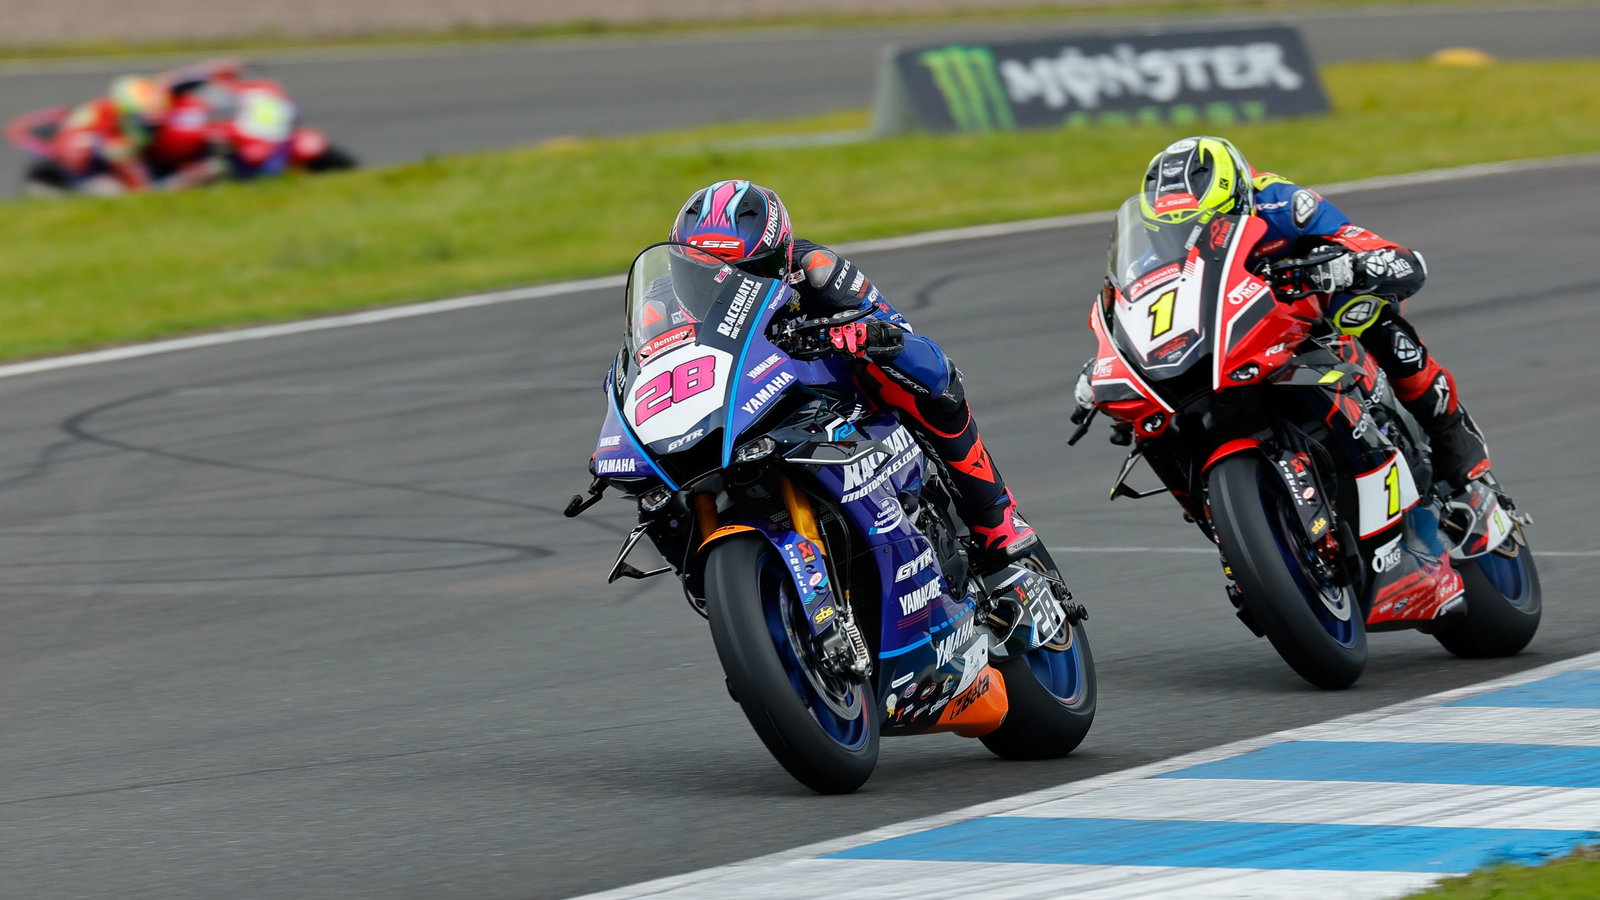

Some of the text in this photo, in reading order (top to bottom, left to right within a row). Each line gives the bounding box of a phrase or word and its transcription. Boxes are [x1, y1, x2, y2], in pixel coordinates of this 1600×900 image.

[1000, 42, 1302, 109] MONSTER
[690, 239, 741, 249] LS2
[763, 200, 779, 248] BURNELL
[717, 277, 755, 337] RACEWAYS
[1149, 287, 1179, 342] 1
[1228, 281, 1262, 305] OMG
[747, 353, 782, 380] YAMALUBE
[635, 355, 716, 427] 28
[741, 371, 794, 415] YAMAHA
[668, 428, 704, 452] GYTR
[598, 457, 635, 473] YAMAHA
[1279, 460, 1303, 506] PIRELLI
[1384, 461, 1400, 521] 1
[1493, 510, 1505, 536] 1
[784, 543, 808, 594] PIRELLI
[895, 547, 934, 583] GYTR
[814, 607, 835, 624] sbs
[1029, 588, 1063, 638] 28
[936, 615, 974, 670] YAMAHA
